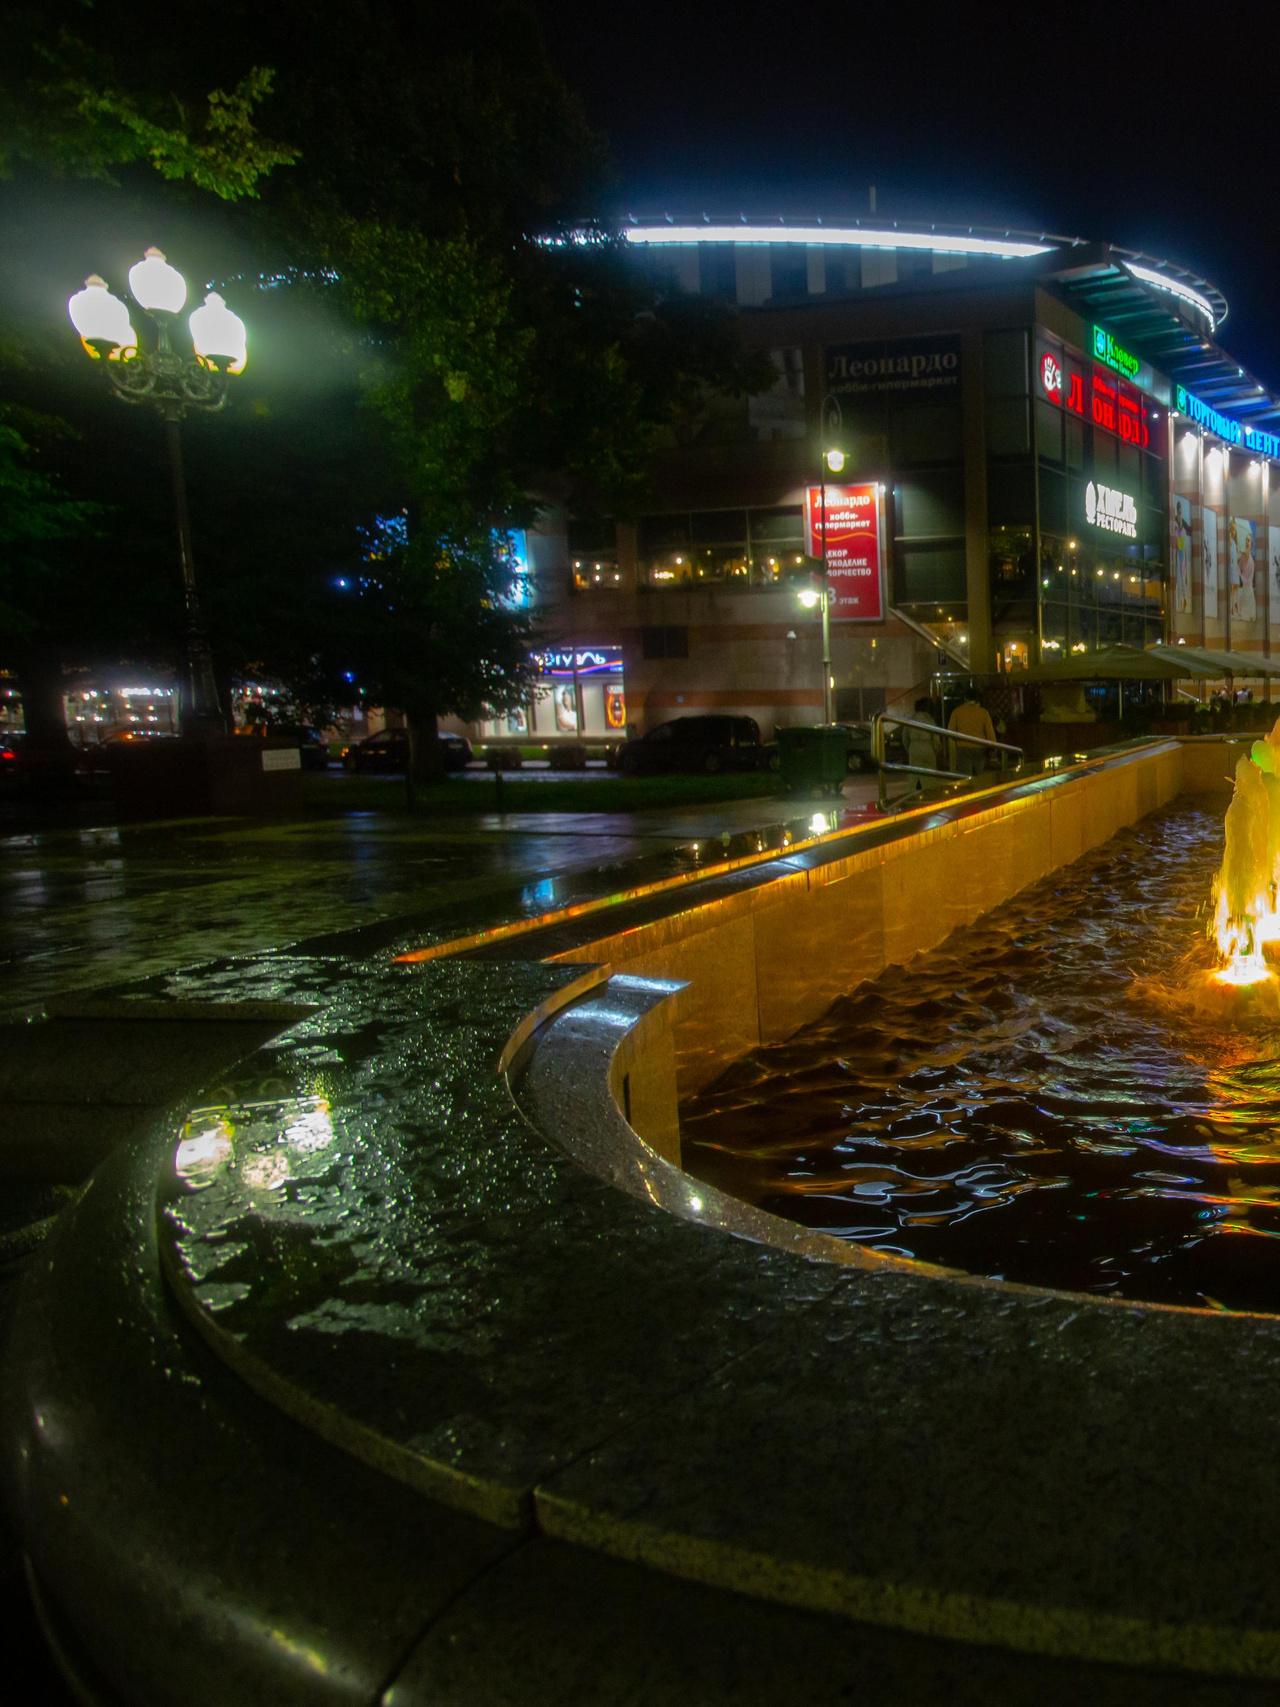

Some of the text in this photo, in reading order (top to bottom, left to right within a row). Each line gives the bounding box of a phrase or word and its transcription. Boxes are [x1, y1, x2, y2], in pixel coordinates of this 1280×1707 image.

[828, 352, 958, 379] Леонардо
[1106, 333, 1139, 376] Кловер
[1188, 393, 1241, 445] ТОРГОВЫЙ
[827, 558, 868, 568] УКОДЕЛИЕ
[827, 568, 872, 577] ВОРЧЕСТВО
